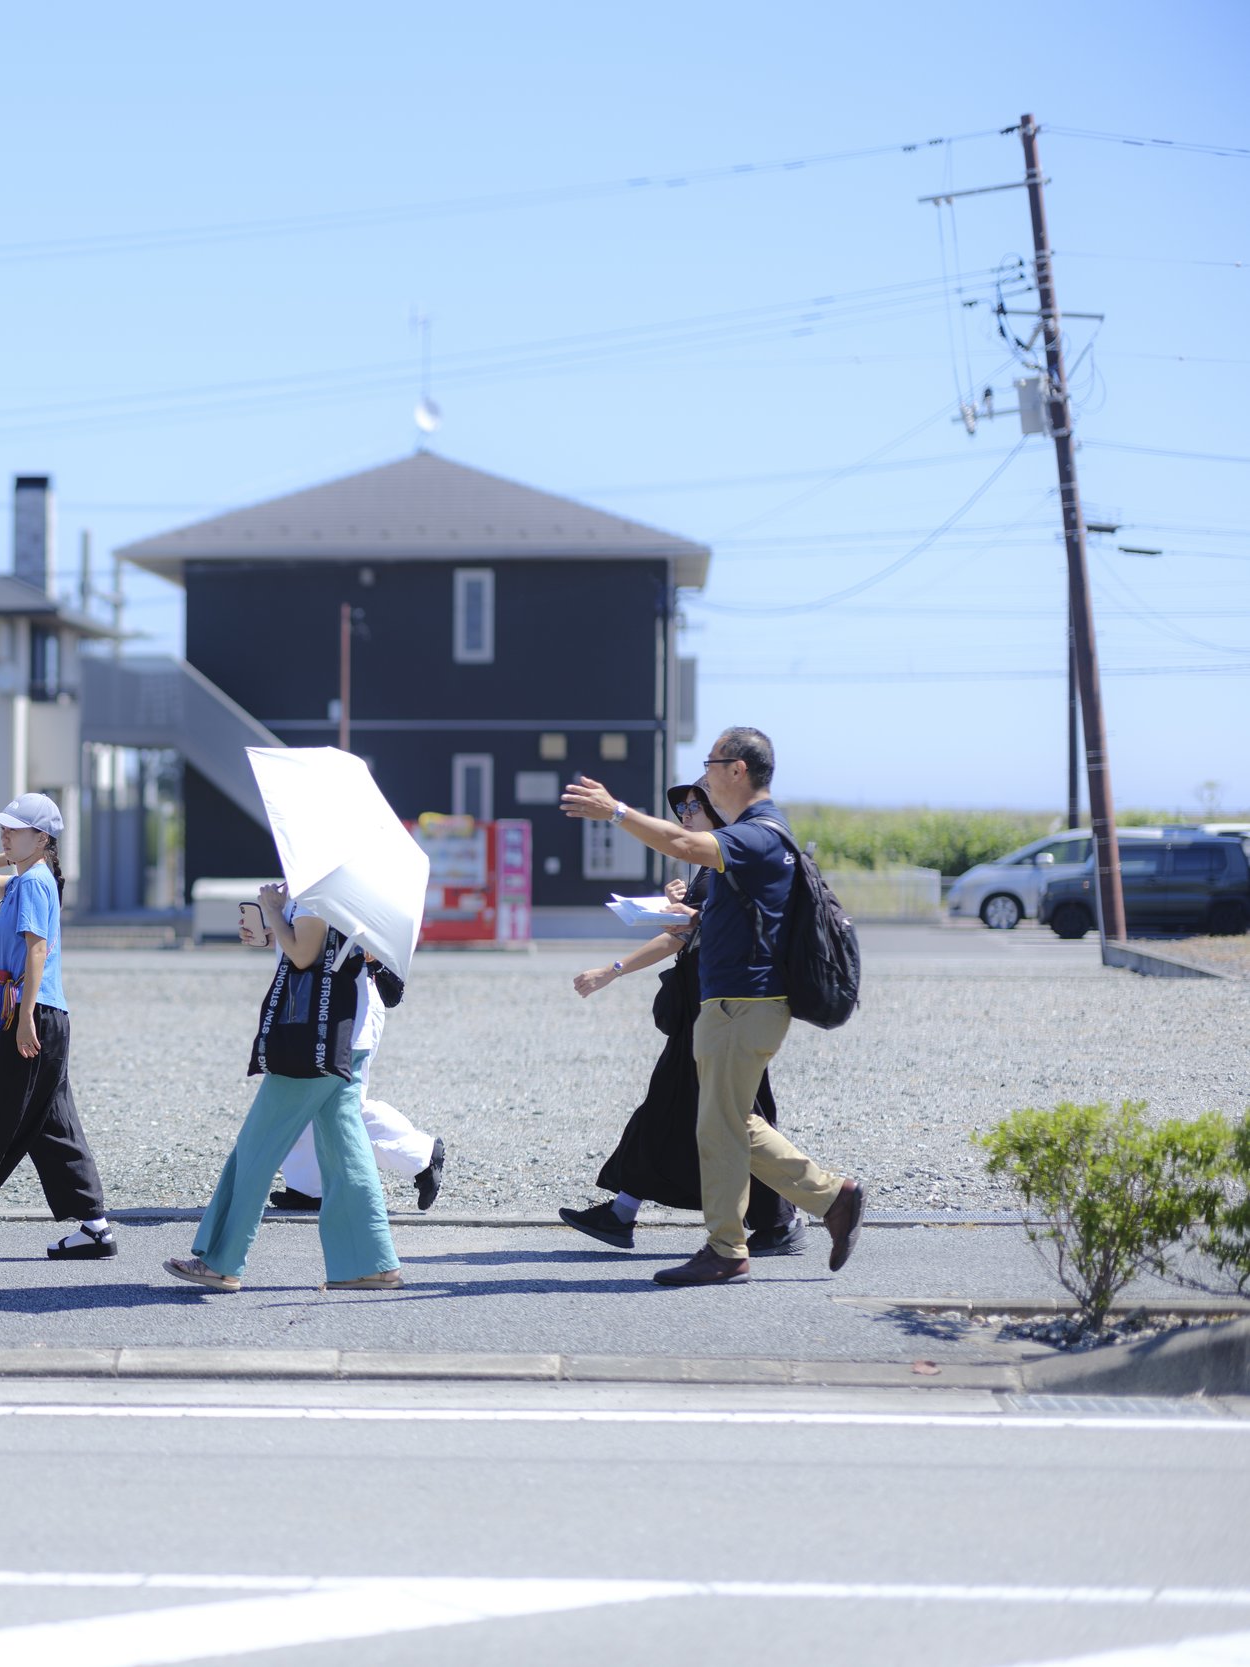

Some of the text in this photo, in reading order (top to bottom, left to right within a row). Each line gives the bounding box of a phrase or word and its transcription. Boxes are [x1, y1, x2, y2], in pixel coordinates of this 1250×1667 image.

[323, 949, 335, 974] STAY
[262, 1008, 275, 1034] STAY
[269, 964, 289, 1007] STRONG
[318, 977, 332, 1021] STRONG
[315, 1042, 326, 1069] STAY
